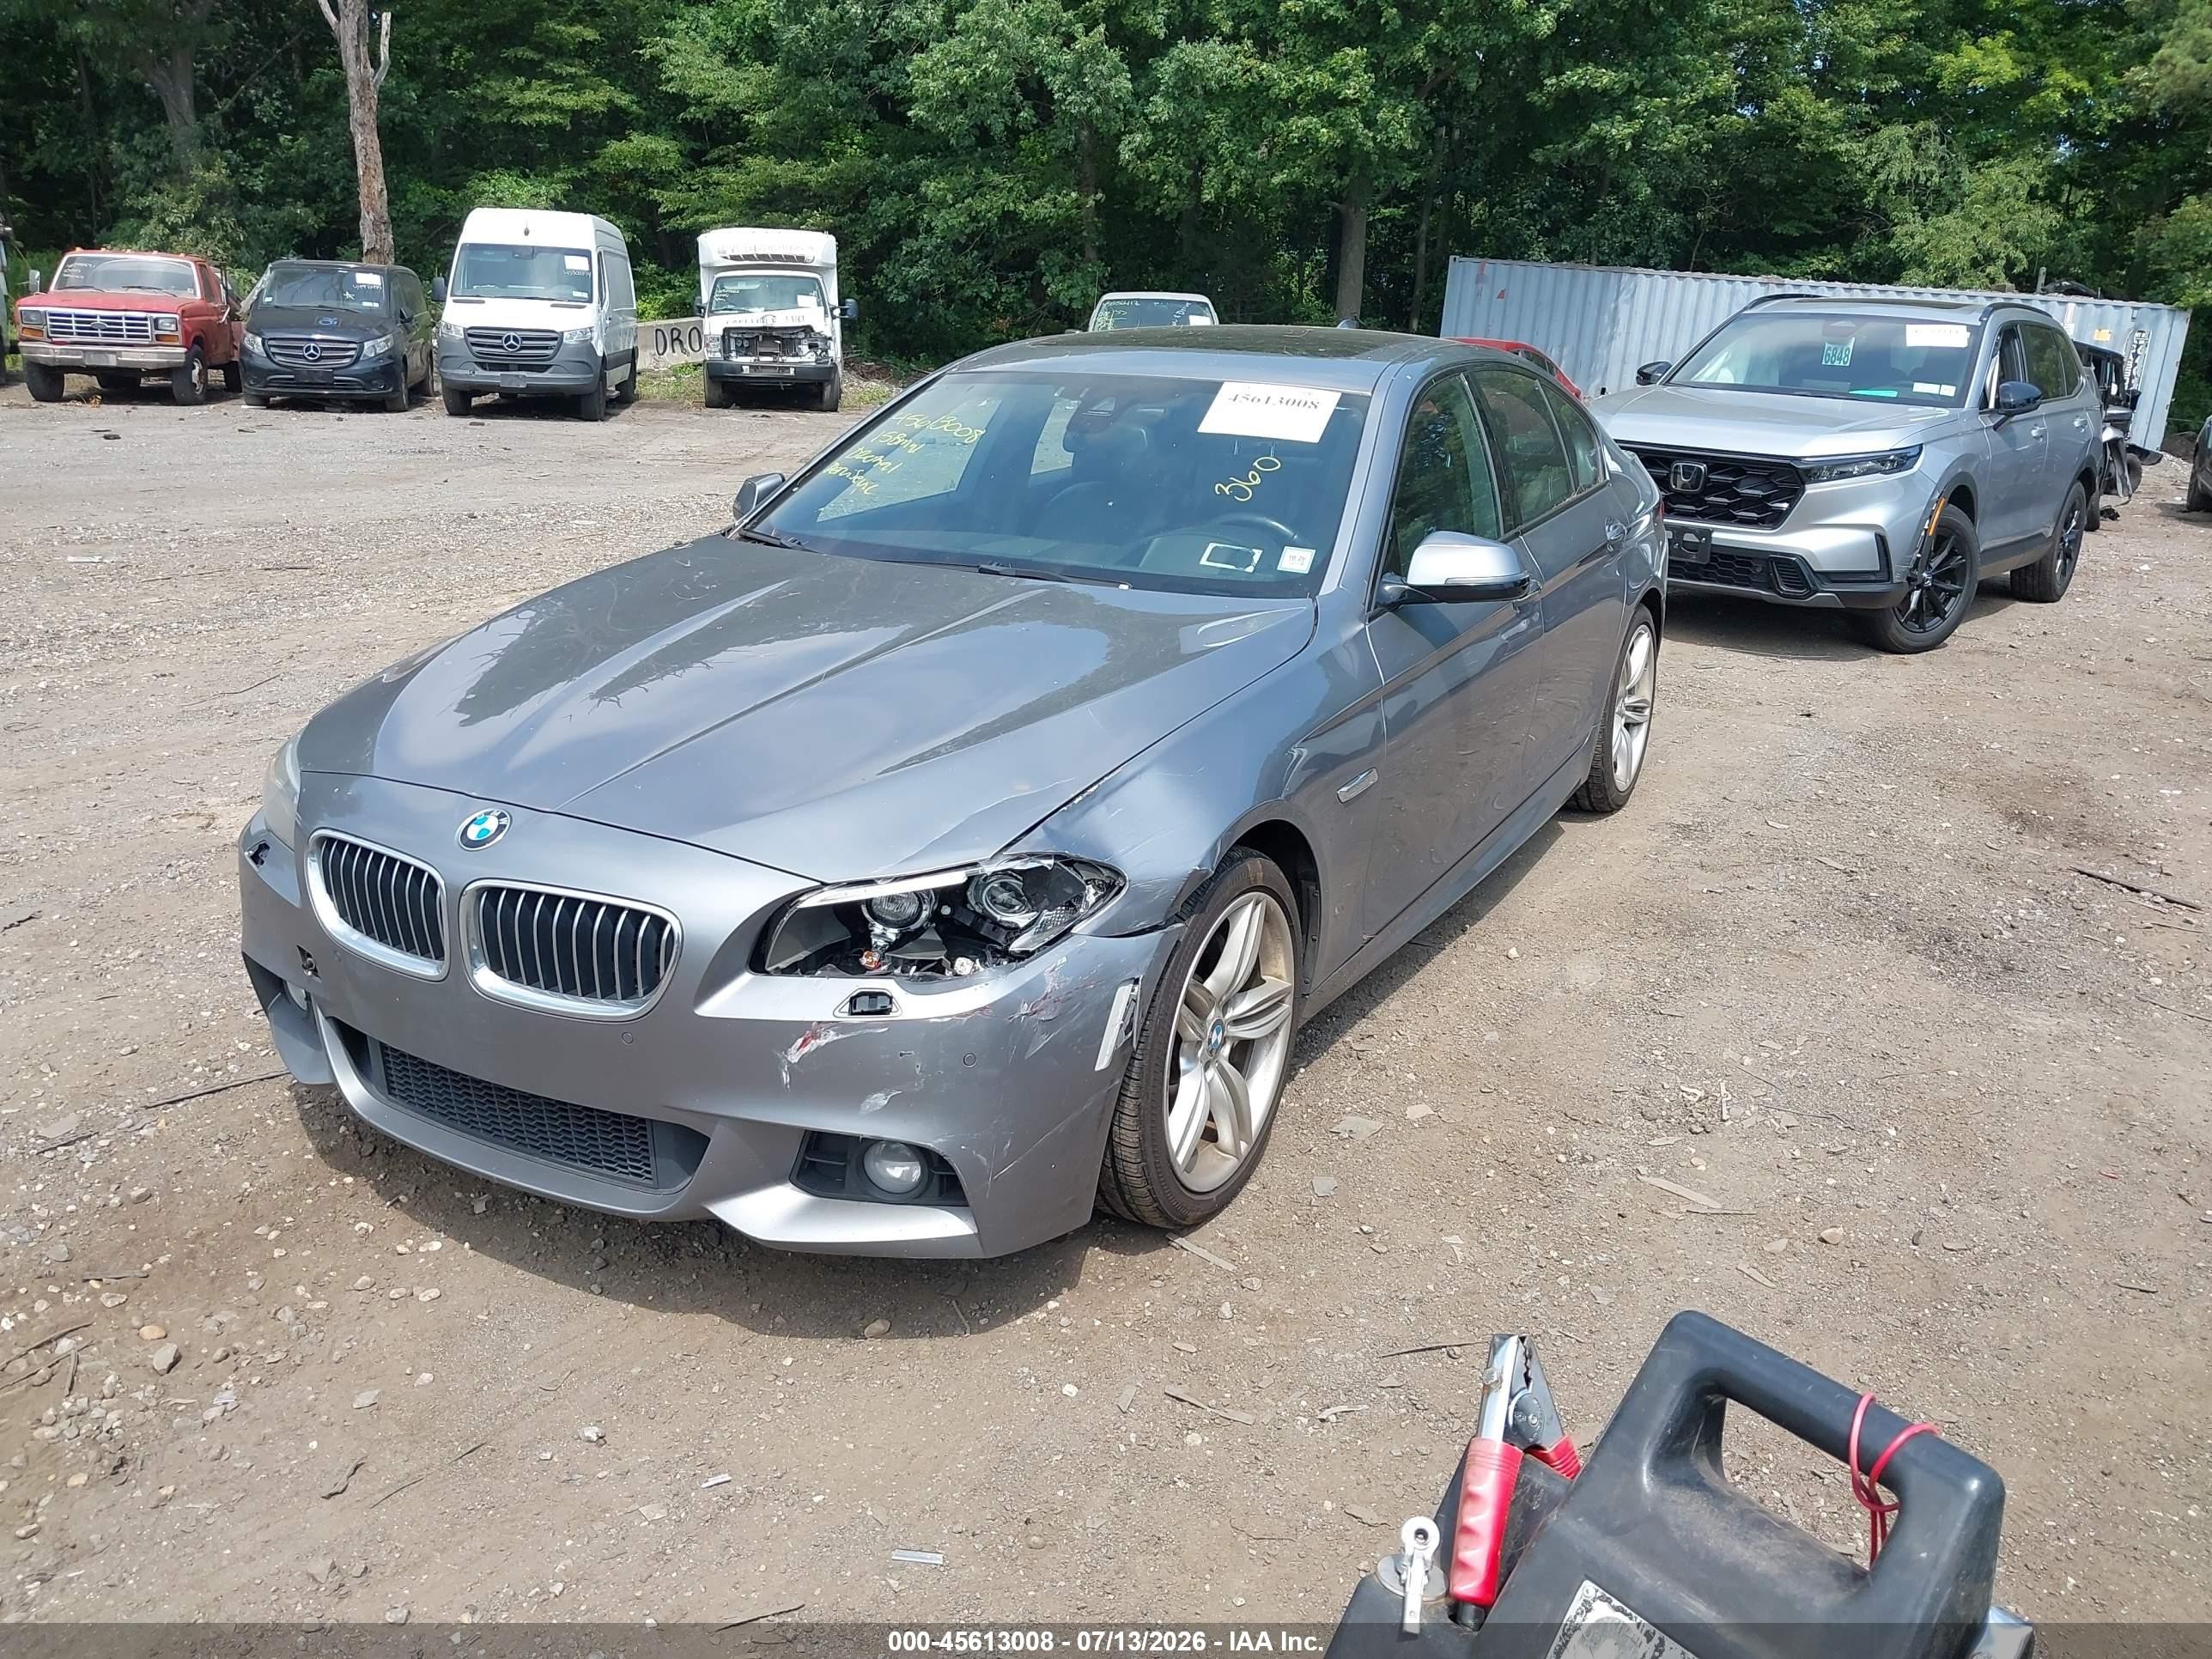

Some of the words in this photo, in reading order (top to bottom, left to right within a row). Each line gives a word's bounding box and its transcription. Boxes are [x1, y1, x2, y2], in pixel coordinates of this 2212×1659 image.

[1823, 345, 1850, 366] 6848
[1227, 392, 1321, 410] 45613008
[1214, 456, 1282, 501] 360
